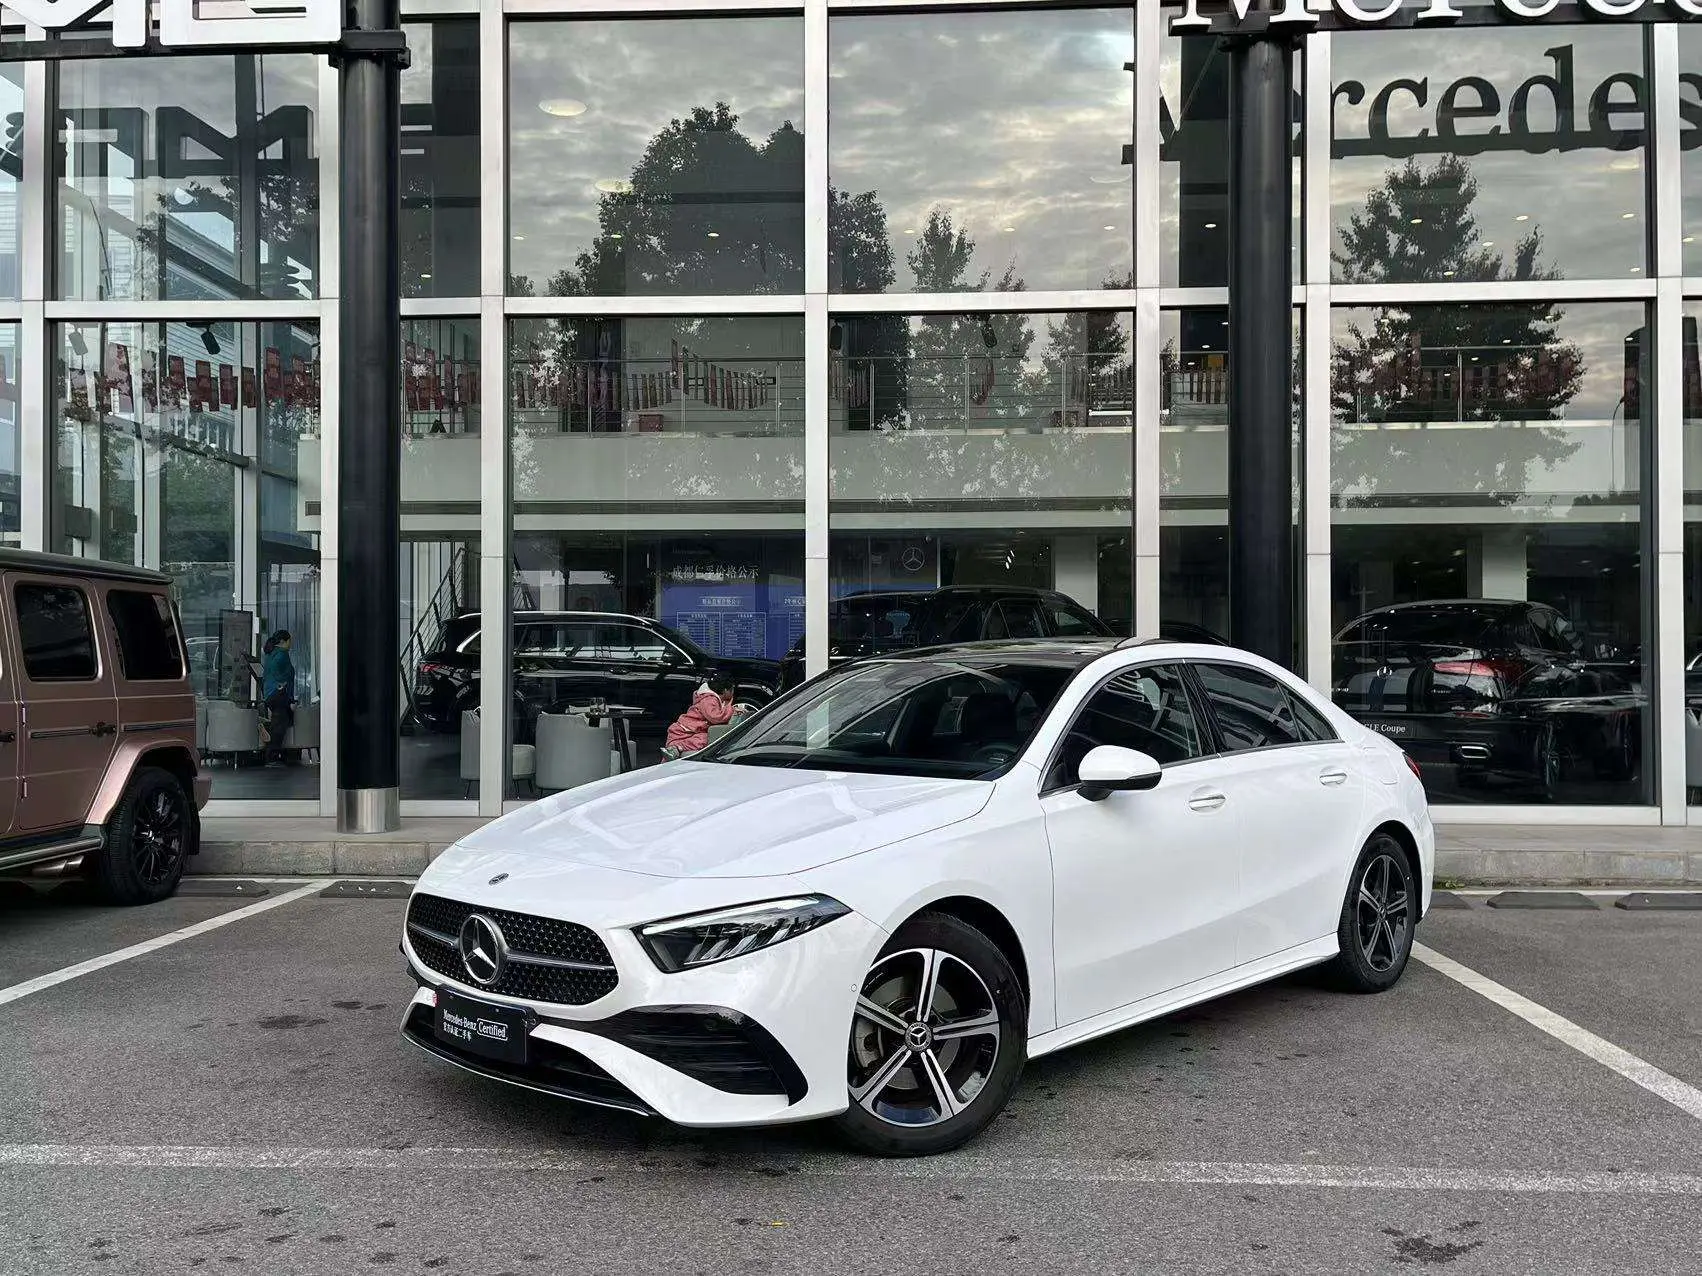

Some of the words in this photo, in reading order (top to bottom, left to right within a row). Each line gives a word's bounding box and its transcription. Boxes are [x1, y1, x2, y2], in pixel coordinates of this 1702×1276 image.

[1381, 724, 1406, 734] Coupe
[443, 1008, 477, 1031] Mercedes-Benz
[478, 1020, 506, 1038] Certified
